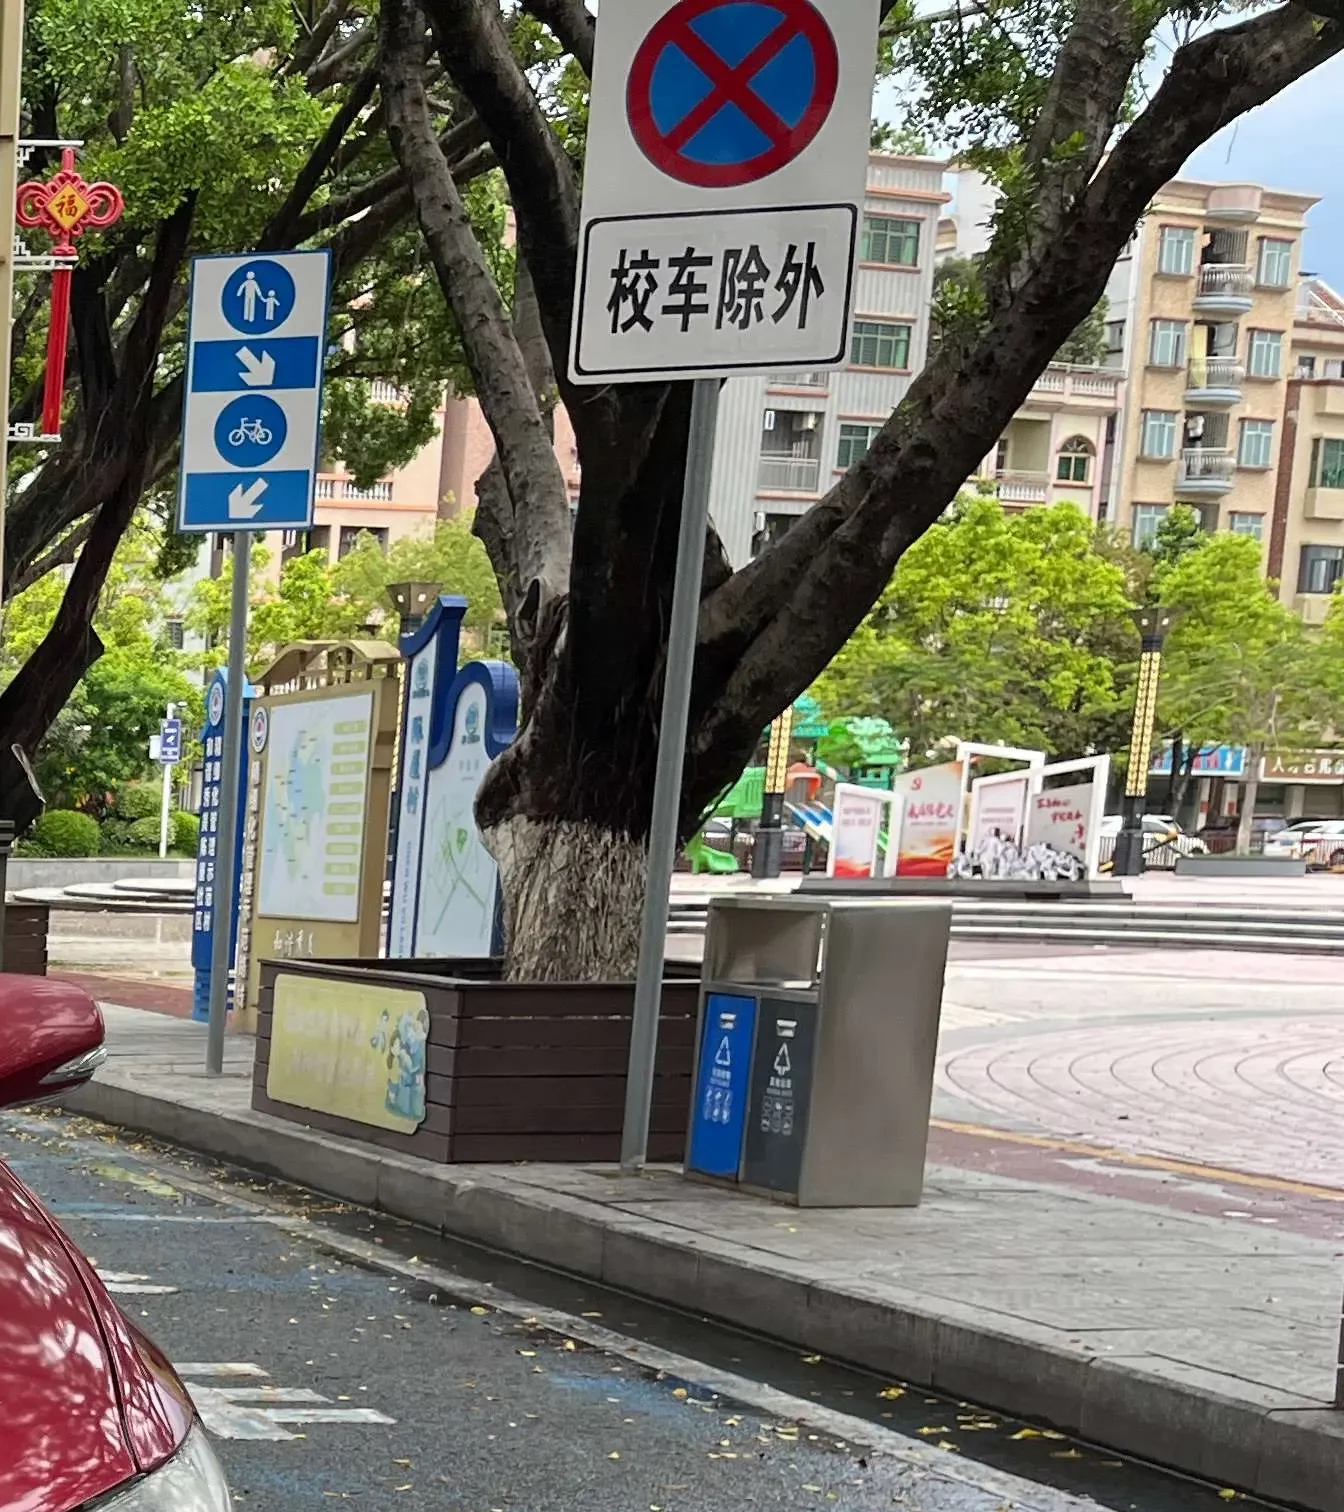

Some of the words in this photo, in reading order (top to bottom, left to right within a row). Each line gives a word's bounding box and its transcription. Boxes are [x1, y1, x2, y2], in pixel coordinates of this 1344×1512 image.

[54, 193, 79, 220] 福
[606, 241, 825, 335] 校车除外
